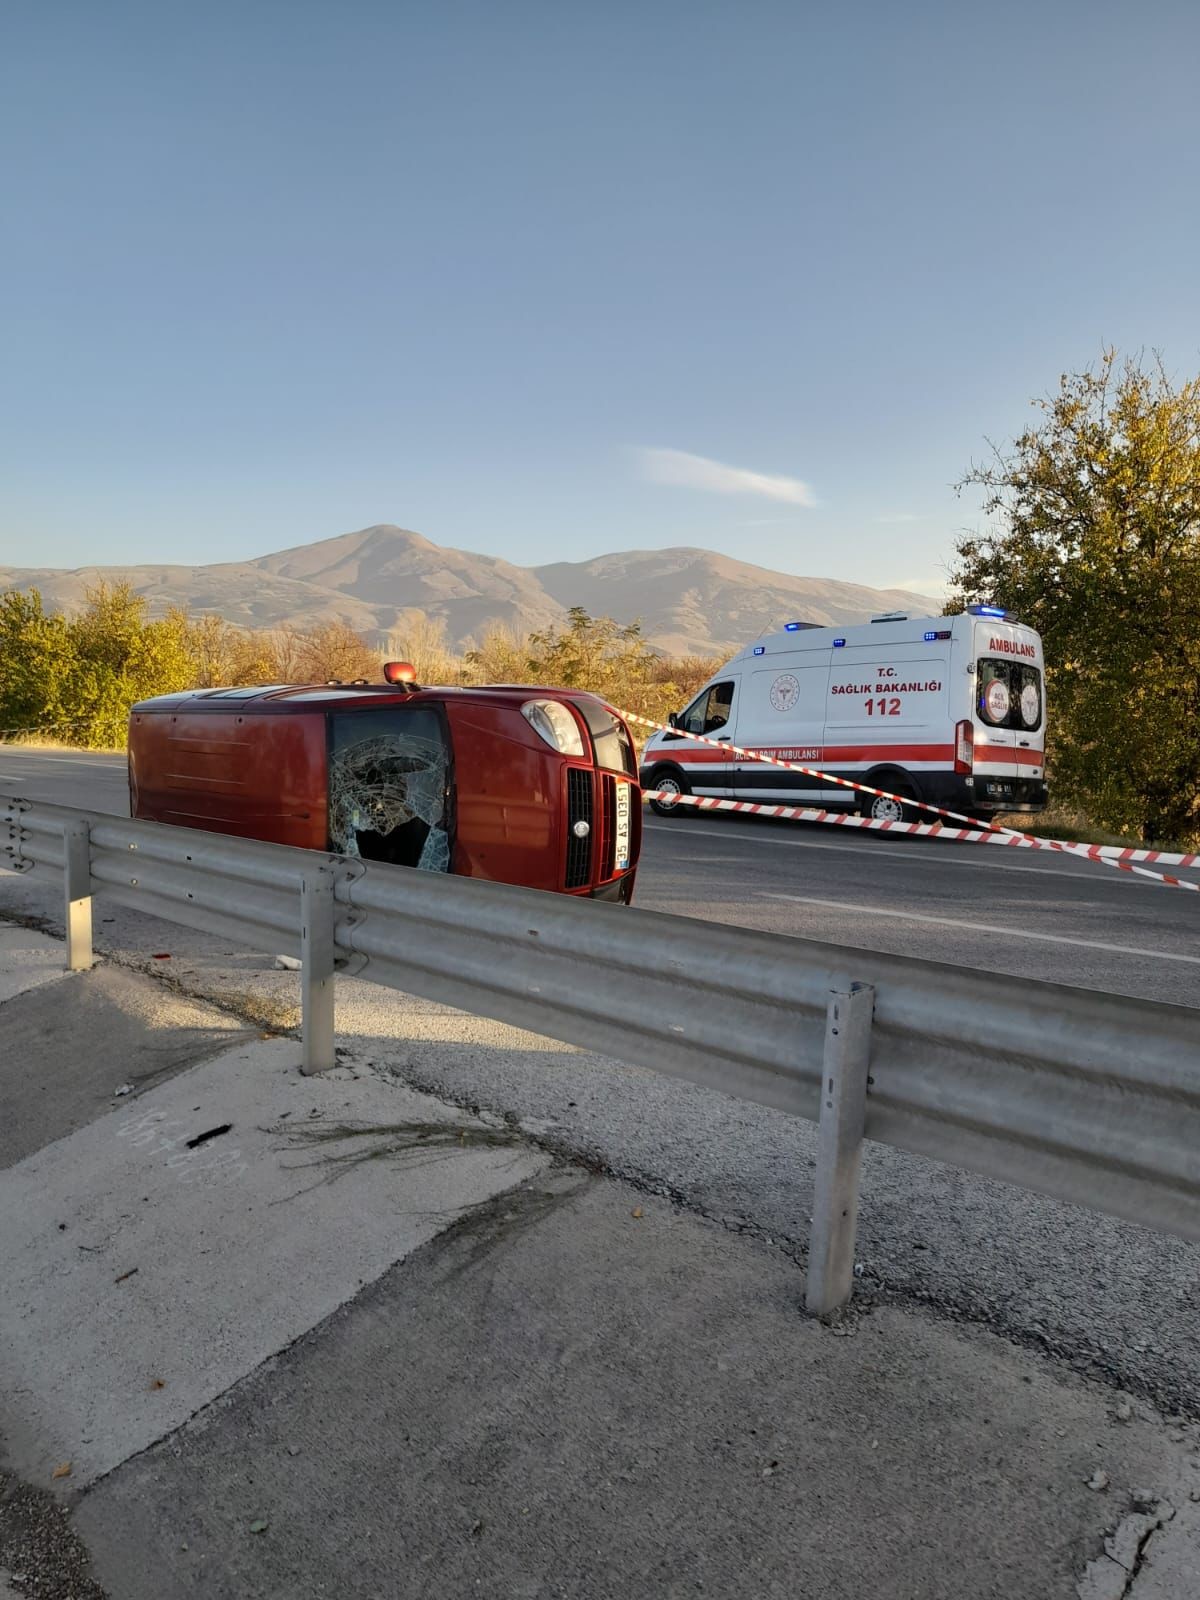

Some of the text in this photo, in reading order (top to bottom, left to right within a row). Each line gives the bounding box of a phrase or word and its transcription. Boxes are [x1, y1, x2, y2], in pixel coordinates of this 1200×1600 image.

[989, 638, 1035, 658] AMBULANS
[877, 668, 898, 677] T.C.
[831, 680, 942, 694] SAĞLIK BAKANLIĞI
[864, 698, 901, 715] 112
[777, 749, 819, 759] AMBULANSI
[618, 787, 628, 817] 0351
[618, 823, 628, 838] AS
[617, 845, 627, 860] 35
